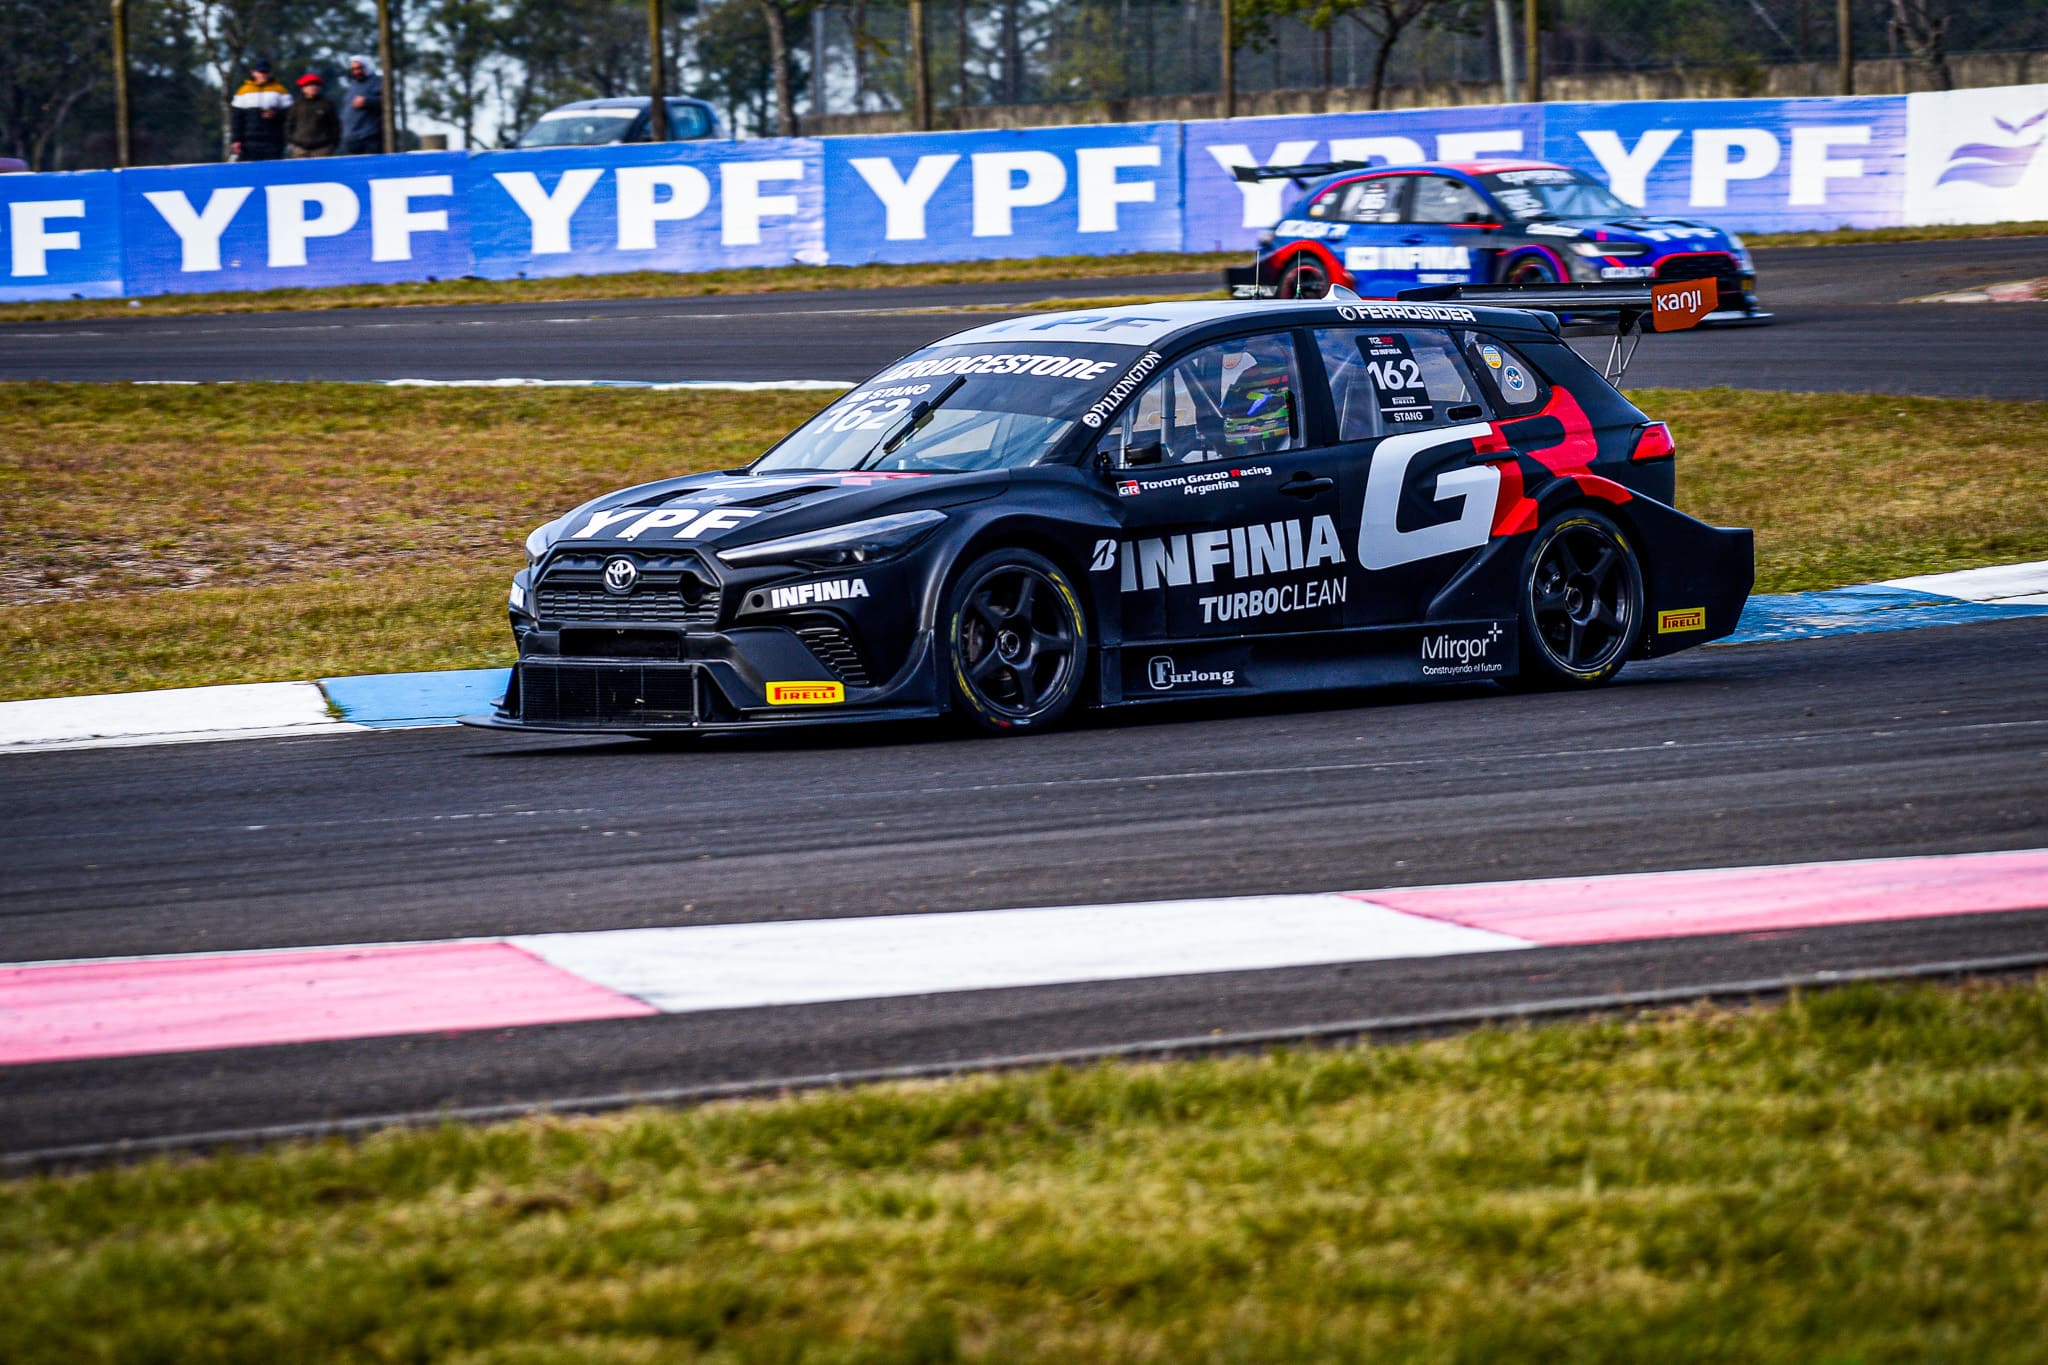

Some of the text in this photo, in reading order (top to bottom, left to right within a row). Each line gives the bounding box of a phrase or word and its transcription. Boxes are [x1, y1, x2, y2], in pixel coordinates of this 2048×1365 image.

[1577, 125, 1872, 208] YPF
[492, 159, 804, 254] YPF
[848, 145, 1162, 241] YPF
[143, 174, 454, 272] YPF
[987, 316, 1173, 333] PF
[1356, 306, 1477, 322] FERROSIDER
[874, 354, 1118, 383] BRIDGESTONE
[1367, 358, 1424, 391] 162
[868, 383, 931, 400] STANG
[1098, 350, 1162, 419] PILKINGTON
[813, 397, 912, 435] 162
[1393, 411, 1424, 422] STANG
[1119, 485, 1140, 496] GR
[1140, 466, 1273, 490] TOYOTA GAZOO Racing
[1184, 480, 1240, 496] Argentina
[571, 508, 762, 541] YPF
[1120, 515, 1346, 592] INFINIA
[770, 578, 872, 609] INFINIA
[1199, 577, 1347, 624] TURBOCLEAN
[1663, 612, 1700, 629] PIRELLI
[1421, 634, 1490, 664] Mirgor
[1153, 660, 1235, 687] Furlong
[1422, 664, 1473, 677] Construyendo
[1481, 662, 1502, 673] futuro
[774, 685, 836, 701] PIRELLI
